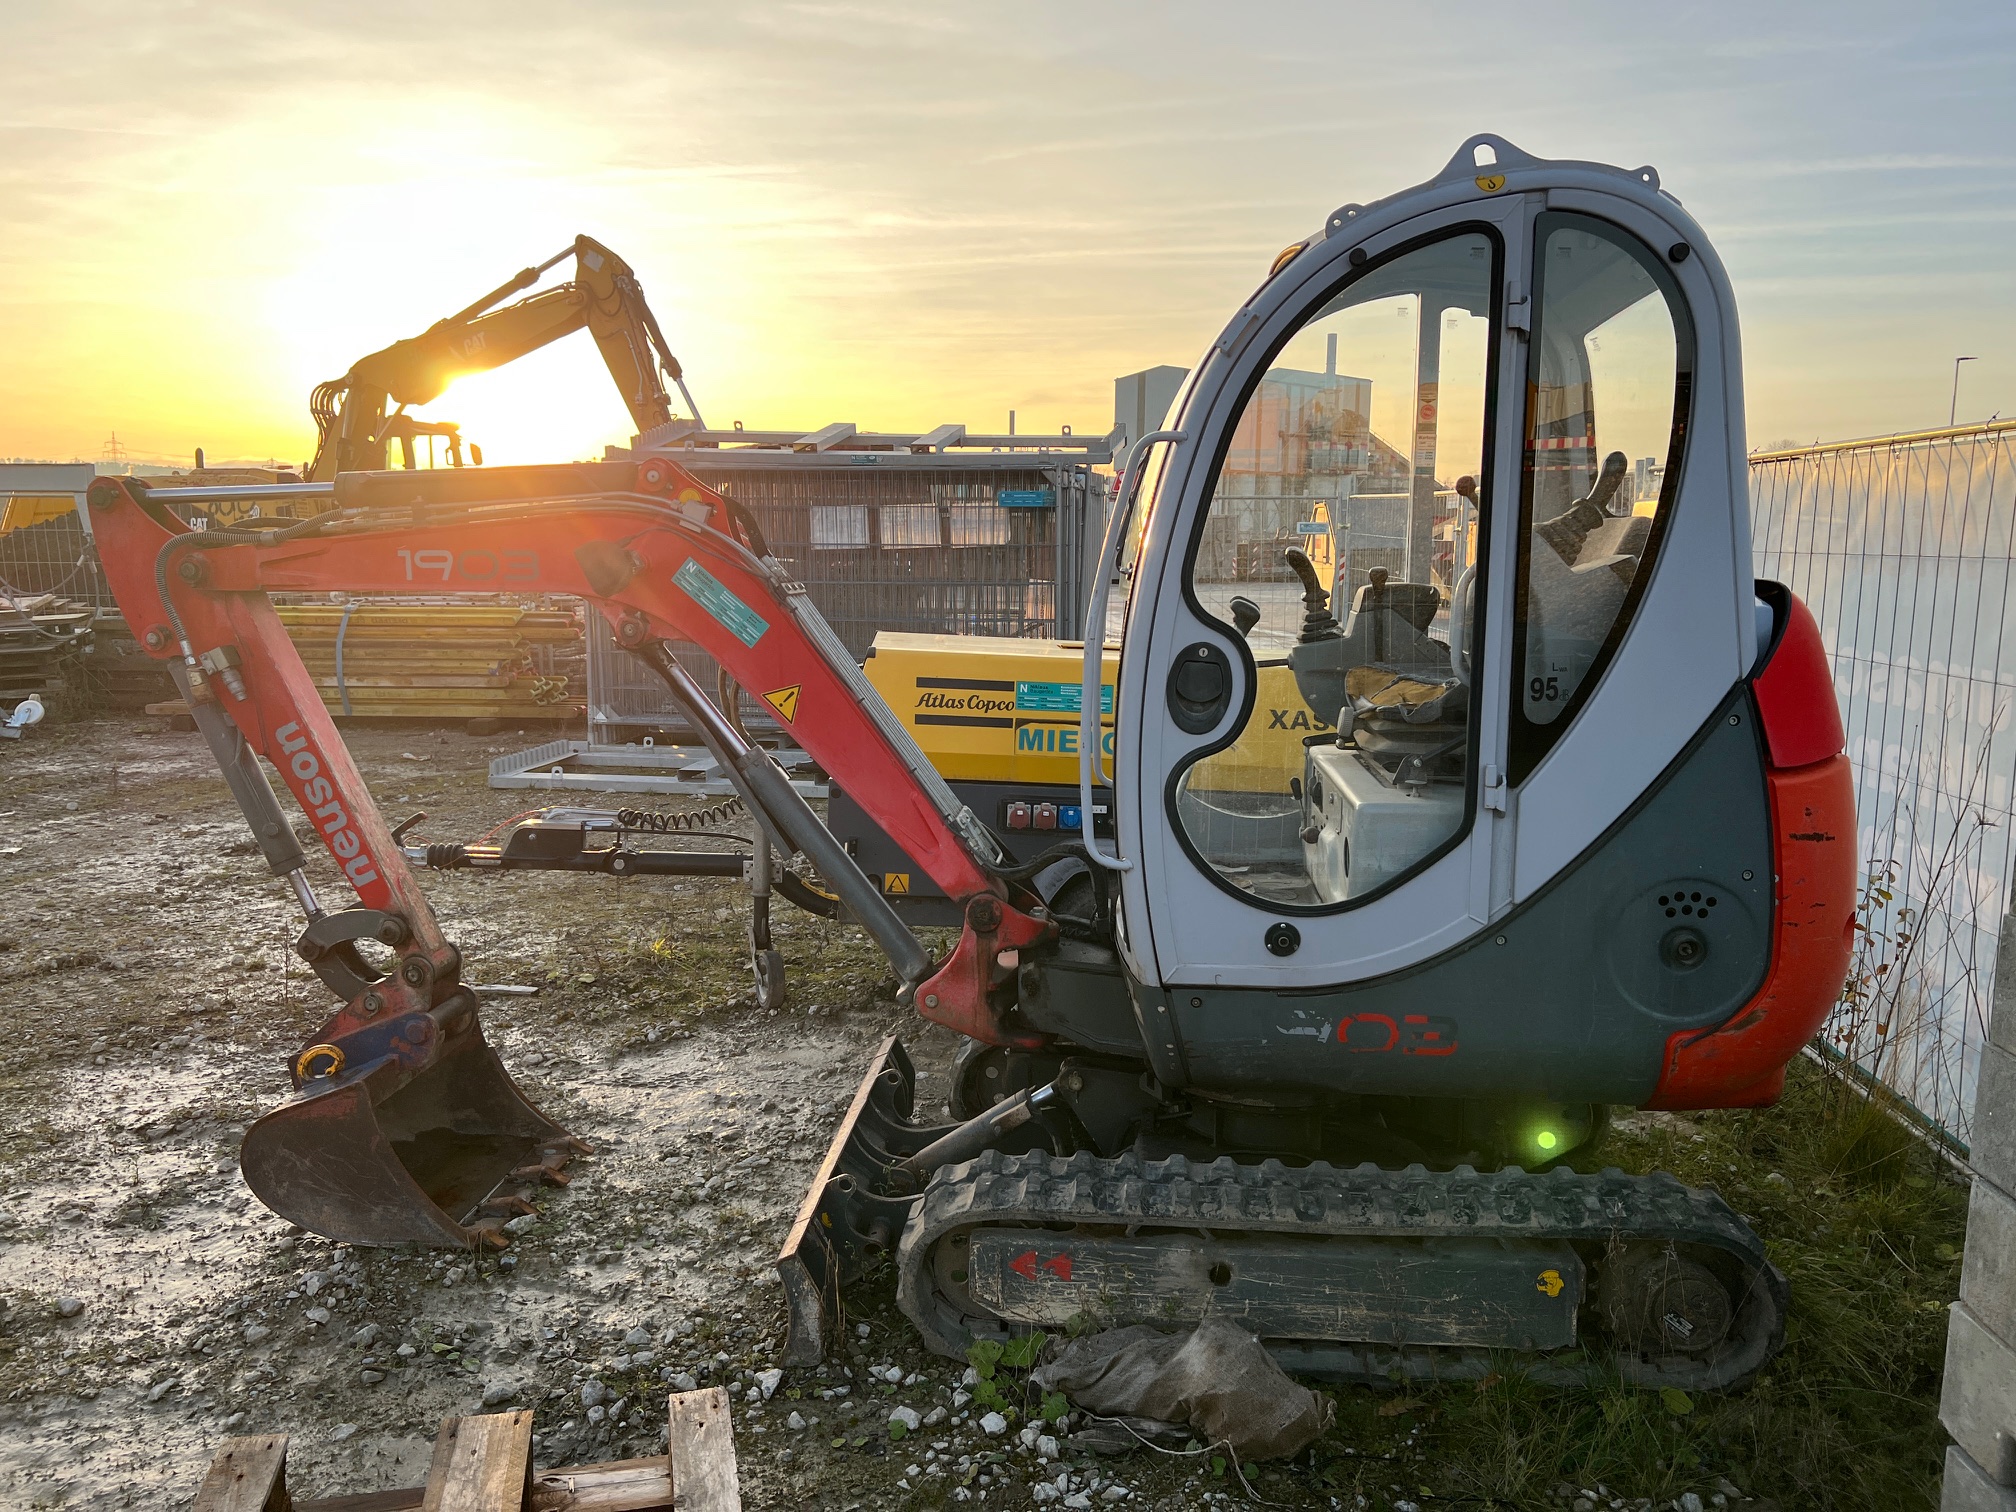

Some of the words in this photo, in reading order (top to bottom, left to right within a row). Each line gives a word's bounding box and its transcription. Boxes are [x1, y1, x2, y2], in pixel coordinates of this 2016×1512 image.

[190, 517, 208, 531] CAT
[397, 549, 540, 582] 1903
[686, 562, 697, 574] N
[1020, 683, 1028, 693] N
[1530, 677, 1559, 702] 95
[915, 692, 965, 710] Atlas
[967, 694, 1015, 714] Copco
[1018, 728, 1113, 755] MIE
[275, 720, 379, 887] neuson
